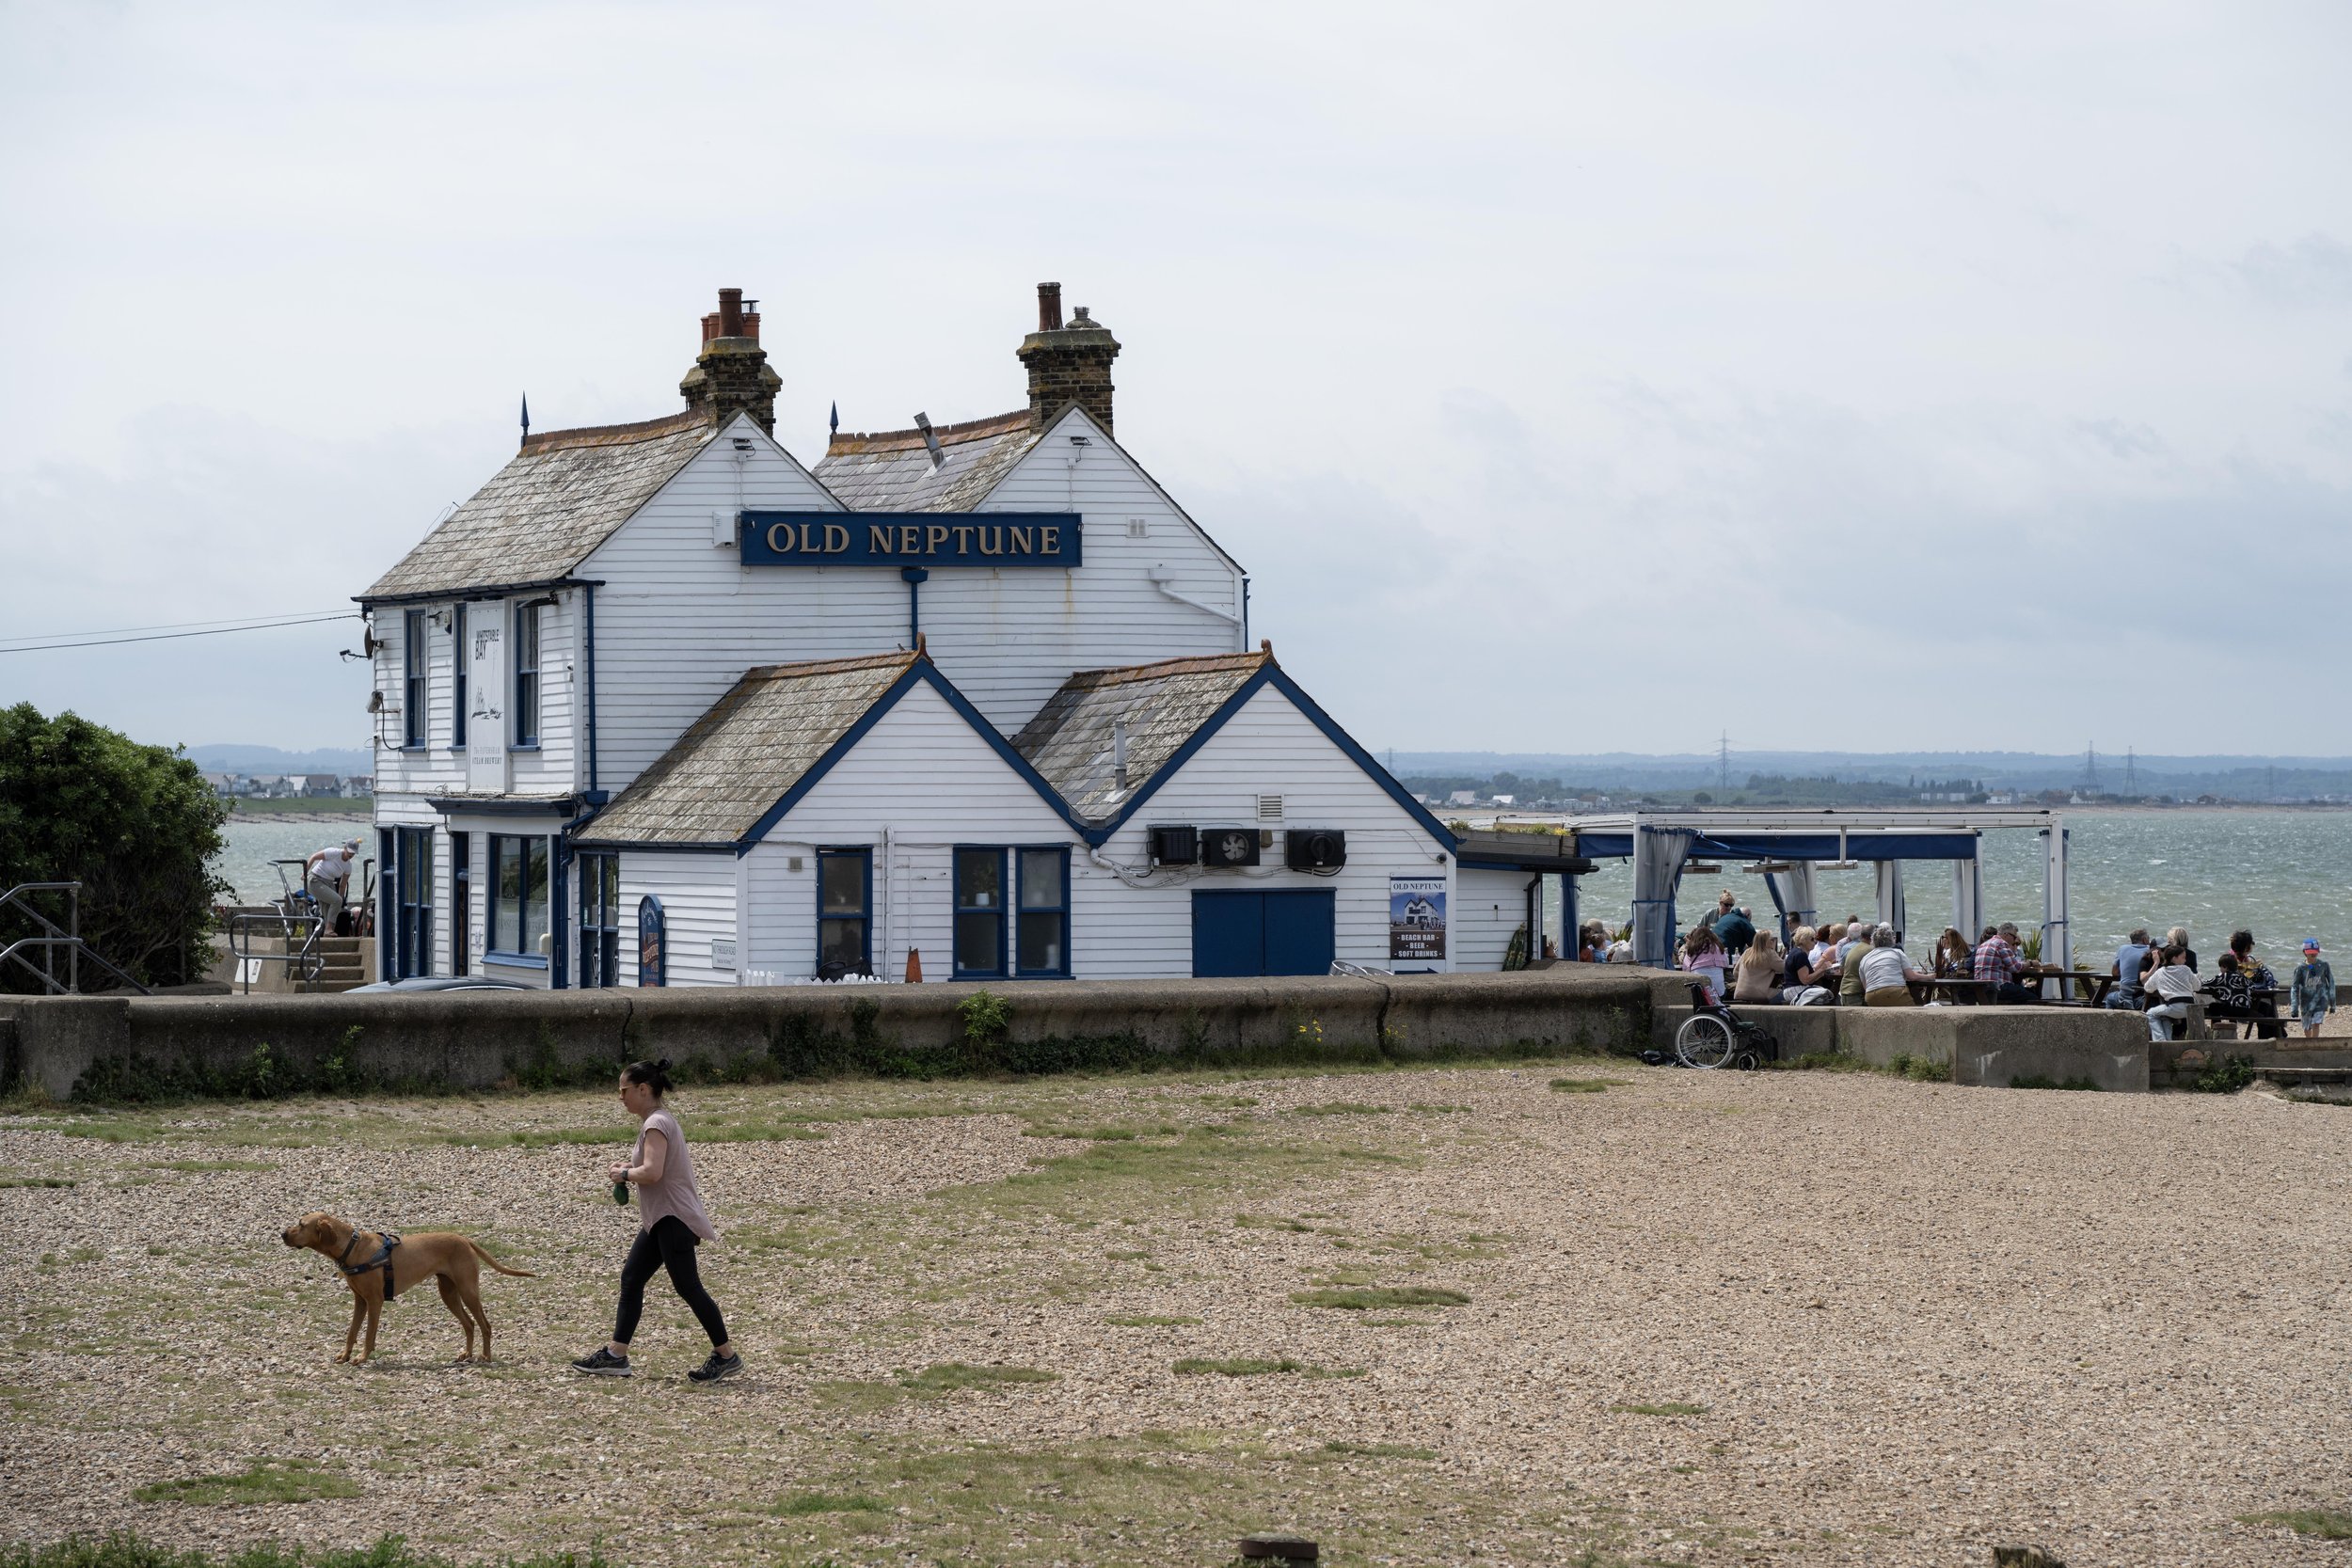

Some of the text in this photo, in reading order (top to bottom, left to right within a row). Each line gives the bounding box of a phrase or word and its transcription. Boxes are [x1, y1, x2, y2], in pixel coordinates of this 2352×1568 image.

[767, 522, 1061, 555] OLD NEPTUNE
[475, 640, 487, 660] BAY
